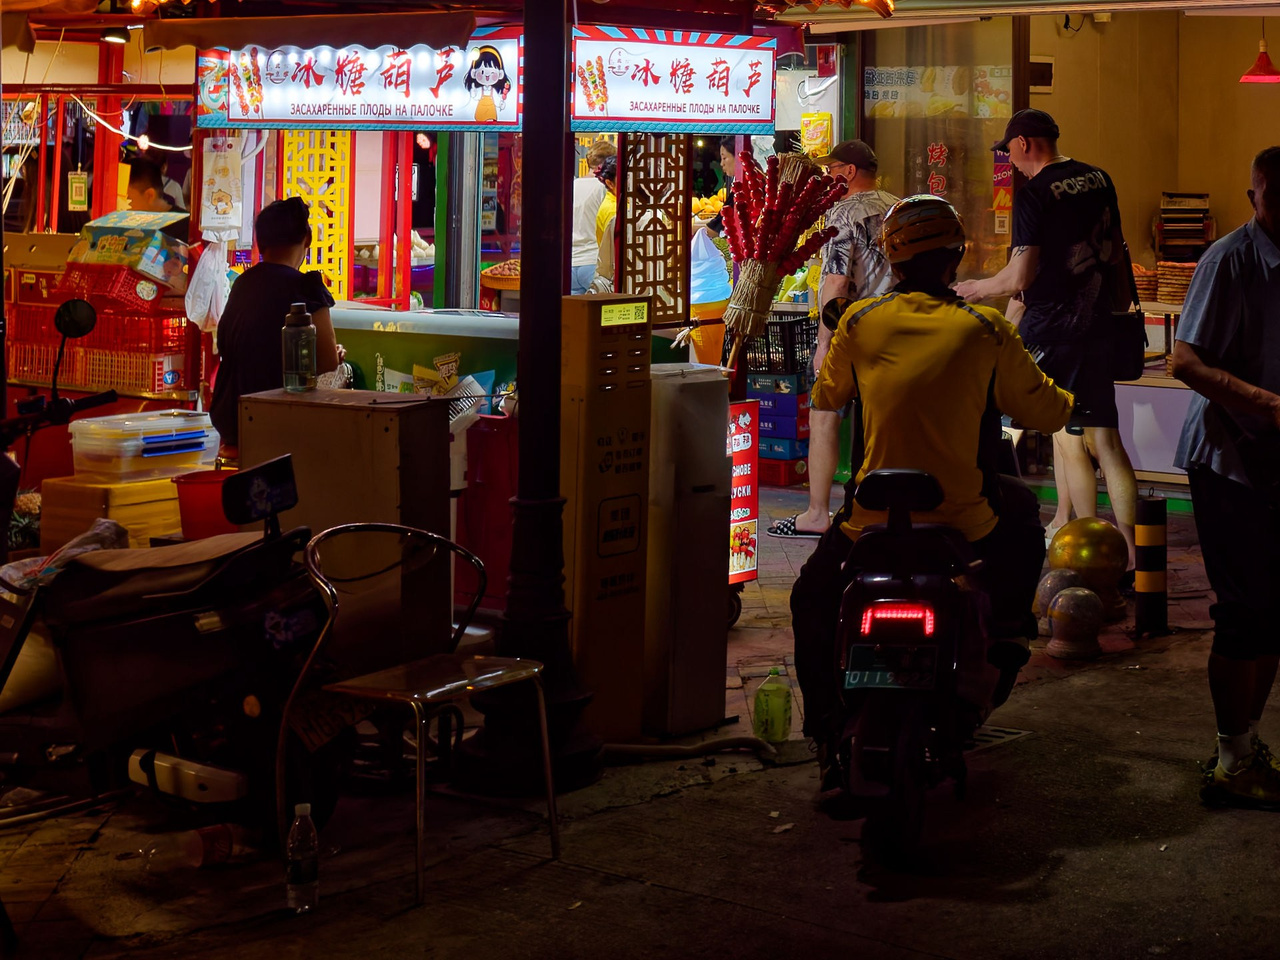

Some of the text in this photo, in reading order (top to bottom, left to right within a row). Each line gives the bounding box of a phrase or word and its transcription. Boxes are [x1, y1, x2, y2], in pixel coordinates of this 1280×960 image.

[631, 56, 761, 99] 冰糖葫芦
[290, 102, 454, 119] ЗАСАХАРЕННЫЕ ПЛОДЫ НА ПАЛОЧКЕ
[629, 100, 761, 117] ЗАСАХАРЕННЫЕ ПЛОДЫ НА ПАЛОЧКЕ
